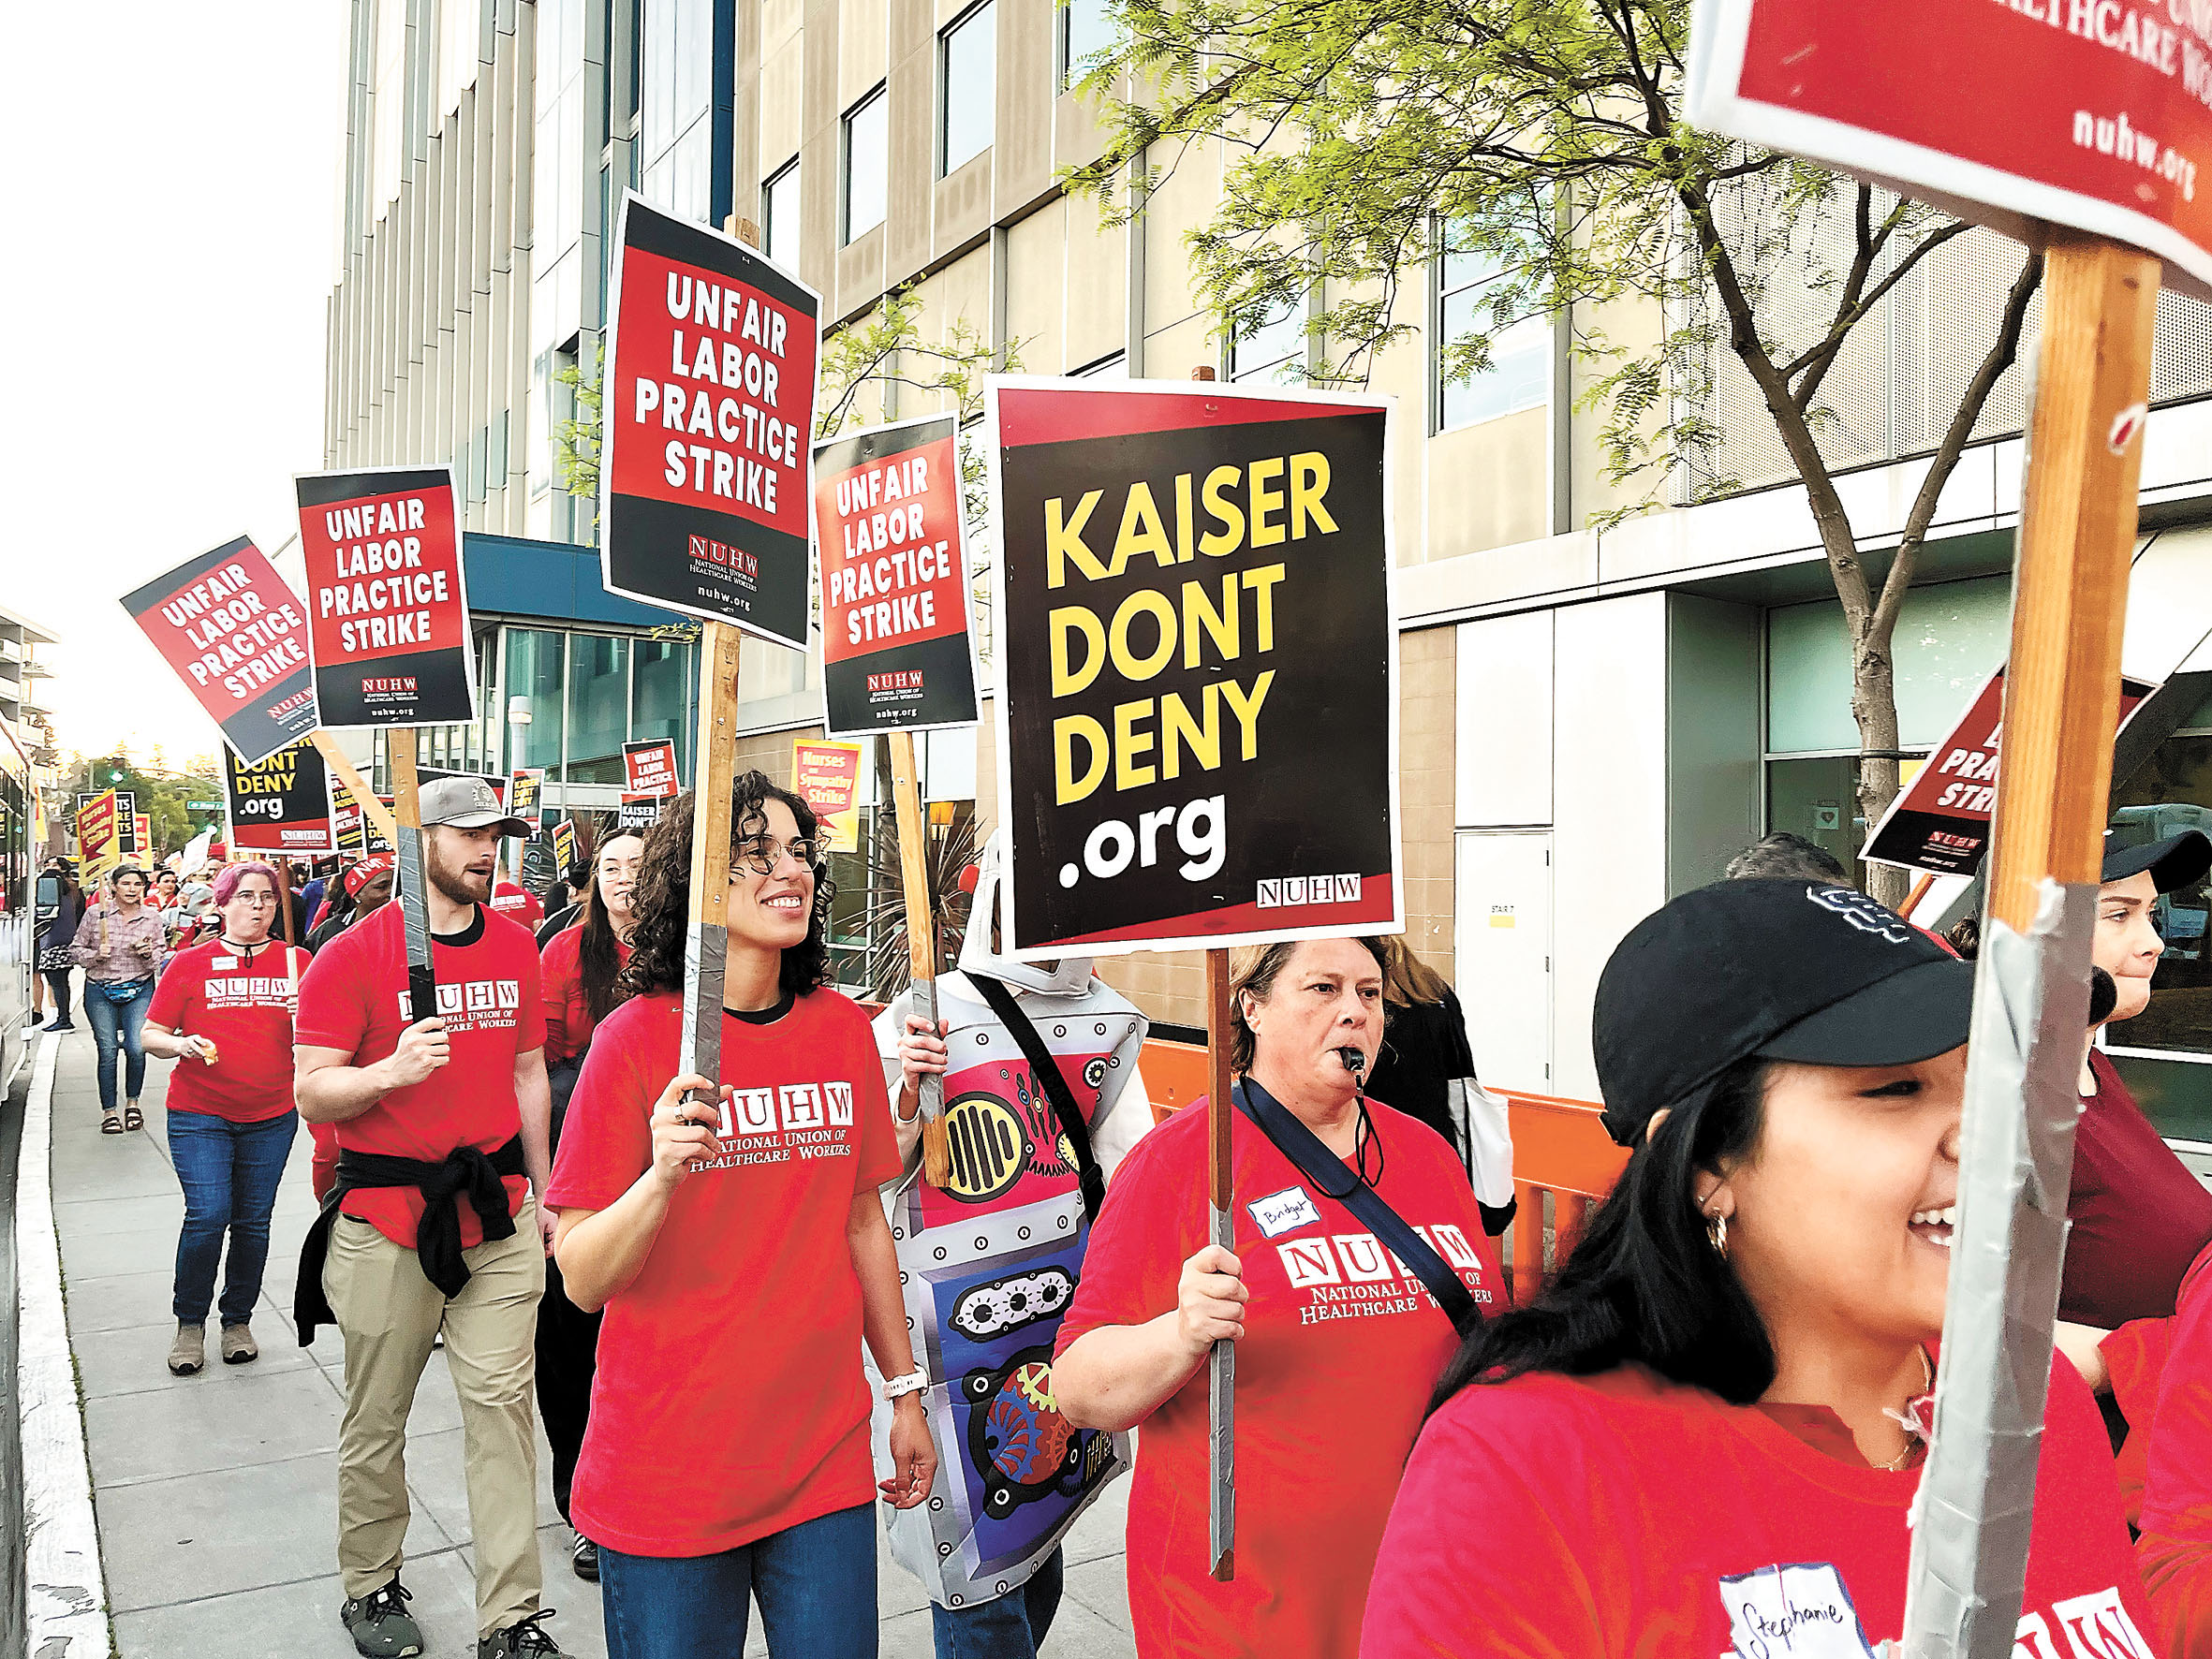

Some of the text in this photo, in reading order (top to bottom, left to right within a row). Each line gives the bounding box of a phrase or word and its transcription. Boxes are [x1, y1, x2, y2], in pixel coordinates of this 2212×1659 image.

[666, 271, 789, 359] UNFAIR
[671, 329, 779, 408] LABOR
[635, 376, 798, 469] PRACTICE
[664, 440, 777, 514] STRIKE
[836, 456, 929, 518] UNFAIR
[325, 498, 426, 542] UNFAIR
[844, 502, 925, 561] LABOR
[1044, 451, 1340, 589] KAISER
[335, 536, 422, 579] LABOR
[689, 535, 758, 577] NUHW
[689, 564, 732, 582] HEALTHCARE
[695, 559, 729, 574] NATIONAL
[830, 539, 951, 609] PRACTICE
[161, 563, 253, 627] UNFAIR
[319, 570, 449, 619] PRACTICE
[698, 586, 751, 612] nuhw.org
[185, 590, 267, 651] LABOR
[340, 610, 432, 653] STRIKE
[847, 590, 936, 646] STRIKE
[1048, 563, 1286, 698] DONT
[187, 603, 303, 687] PRACTICE
[223, 637, 307, 699] STRIKE
[361, 677, 418, 692] NUHW
[867, 669, 923, 691] NUHW
[876, 709, 918, 719] nuhw.org
[1053, 669, 1276, 806] DENY
[802, 751, 846, 768] Nurses
[236, 772, 296, 795] DENY
[808, 788, 847, 805] Strike
[239, 798, 284, 819] .org
[622, 806, 655, 816] KAISER
[1058, 794, 1227, 889] .org
[1257, 874, 1361, 907] NUHW
[468, 1010, 500, 1021] UNION
[717, 1087, 851, 1131] UHW
[717, 1129, 847, 1153] ATIONAL UNION OF
[798, 1144, 851, 1160] WORKERS
[1262, 1200, 1306, 1225] Bridget
[1283, 1228, 1475, 1282] NUW
[1311, 1282, 1401, 1304] NATIONAL
[1466, 1271, 1482, 1285] OF
[1299, 1298, 1418, 1326] HEALTHCARE
[1742, 1599, 1843, 1659] Stephanie
